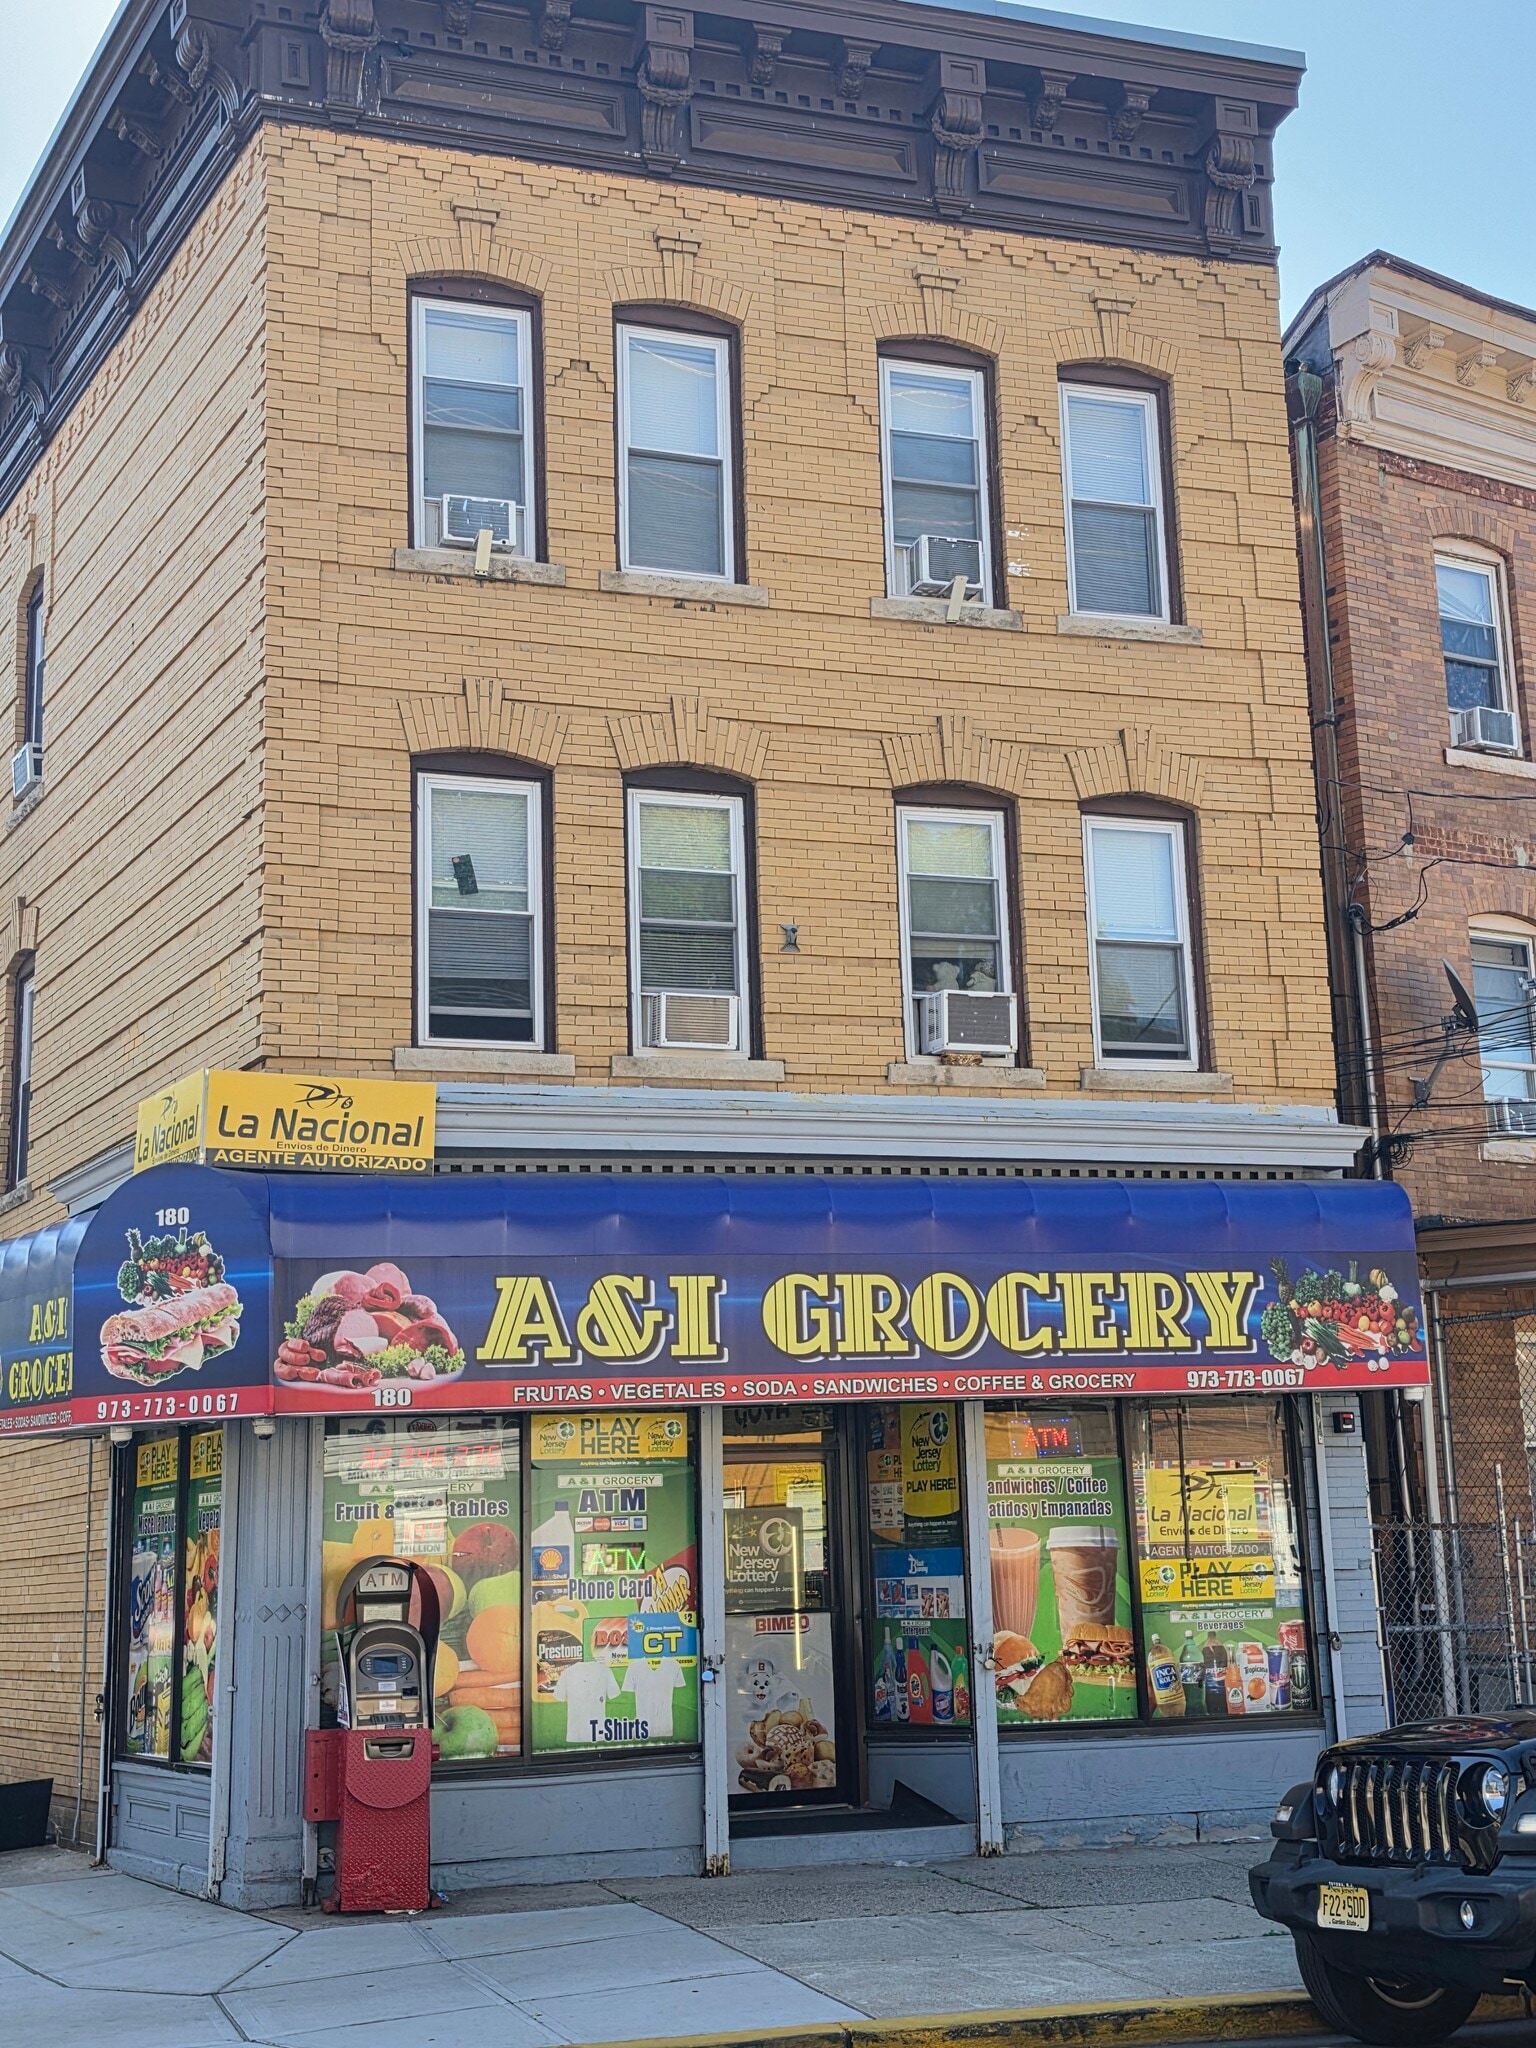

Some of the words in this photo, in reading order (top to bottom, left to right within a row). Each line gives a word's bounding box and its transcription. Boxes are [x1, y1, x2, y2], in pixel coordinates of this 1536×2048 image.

[218, 1105, 259, 1138] La
[270, 1107, 424, 1147] Nacional
[137, 1134, 149, 1163] La
[151, 1104, 199, 1157] Nacional
[316, 1143, 329, 1151] de
[332, 1144, 367, 1154] Dinero
[214, 1149, 295, 1165] AGENTE
[300, 1153, 426, 1171] AUTORIZADO
[155, 1207, 190, 1227] 180
[762, 1271, 1261, 1361] GROCERY
[1186, 1368, 1305, 1388] 973-773-0067
[514, 1385, 593, 1403] FRUTAS
[609, 1381, 726, 1399] VEGETALES
[743, 1379, 798, 1397] SODA
[813, 1376, 938, 1394] SANDWICHES
[954, 1374, 1028, 1391] COFFEE
[1031, 1374, 1044, 1391] &
[1048, 1372, 1136, 1390] GROCERY
[370, 1388, 412, 1407] 180
[97, 1393, 239, 1420] 973-773-0067
[580, 1417, 642, 1437] PLAY
[647, 1432, 665, 1440] New
[911, 1436, 929, 1448] New
[1024, 1426, 1068, 1447] ATM
[543, 1440, 568, 1449] Jersey
[580, 1436, 641, 1455] HERE
[648, 1445, 674, 1454] Lottery
[651, 1439, 674, 1448] Jersey
[151, 1443, 171, 1461] PLAY
[540, 1447, 567, 1455] Lottery
[916, 1447, 942, 1460] Jersey
[206, 1453, 222, 1473] HER
[912, 1459, 942, 1472] Lottery
[151, 1461, 170, 1481] HERE
[1038, 1466, 1085, 1475] GROCERY
[580, 1477, 588, 1485] &
[602, 1476, 655, 1485] GROCERY
[906, 1480, 928, 1493] PLAY
[929, 1478, 957, 1491] HERE!
[987, 1478, 1056, 1495] andwiches
[1067, 1477, 1107, 1493] Coffee
[578, 1489, 646, 1513] ATM
[335, 1502, 379, 1521] Fruit
[450, 1498, 510, 1518] tables
[989, 1501, 1029, 1517] atidos
[1031, 1503, 1038, 1518] y
[1041, 1499, 1112, 1517] Empanadas
[1151, 1506, 1171, 1522] La
[1178, 1505, 1252, 1523] Nacional
[198, 1508, 221, 1533] Vegeta
[1198, 1525, 1211, 1535] de
[1213, 1525, 1249, 1536] Diero
[401, 1543, 441, 1553] MILLION
[729, 1544, 760, 1556] New
[1151, 1545, 1192, 1557] AGENT
[1194, 1544, 1259, 1556] AUTORZADO
[588, 1548, 646, 1573] ATM
[736, 1558, 779, 1571] Jersey
[729, 1570, 779, 1583] Lottery
[1179, 1561, 1232, 1580] PLAY
[365, 1572, 403, 1586] ATM
[1243, 1581, 1263, 1589] Jersey
[568, 1578, 615, 1600] Phone
[618, 1575, 653, 1599] Card
[754, 1586, 775, 1594] happen
[1146, 1590, 1170, 1598] Lottery
[1150, 1584, 1170, 1593] Jersey
[1181, 1579, 1234, 1598] HERE
[1240, 1587, 1263, 1595] Lottery
[684, 1612, 693, 1623] $2
[1213, 1609, 1265, 1619] GROCERY
[755, 1615, 810, 1632] BIMBO
[1197, 1621, 1244, 1631] Beverages
[902, 1626, 930, 1636] Detergents
[643, 1631, 683, 1654] CT
[538, 1643, 583, 1659] Prestone
[1155, 1667, 1176, 1679] INCA
[1244, 1665, 1268, 1675] Tropicana
[1158, 1675, 1176, 1685] KOLA
[590, 1718, 649, 1742] T-Shirts
